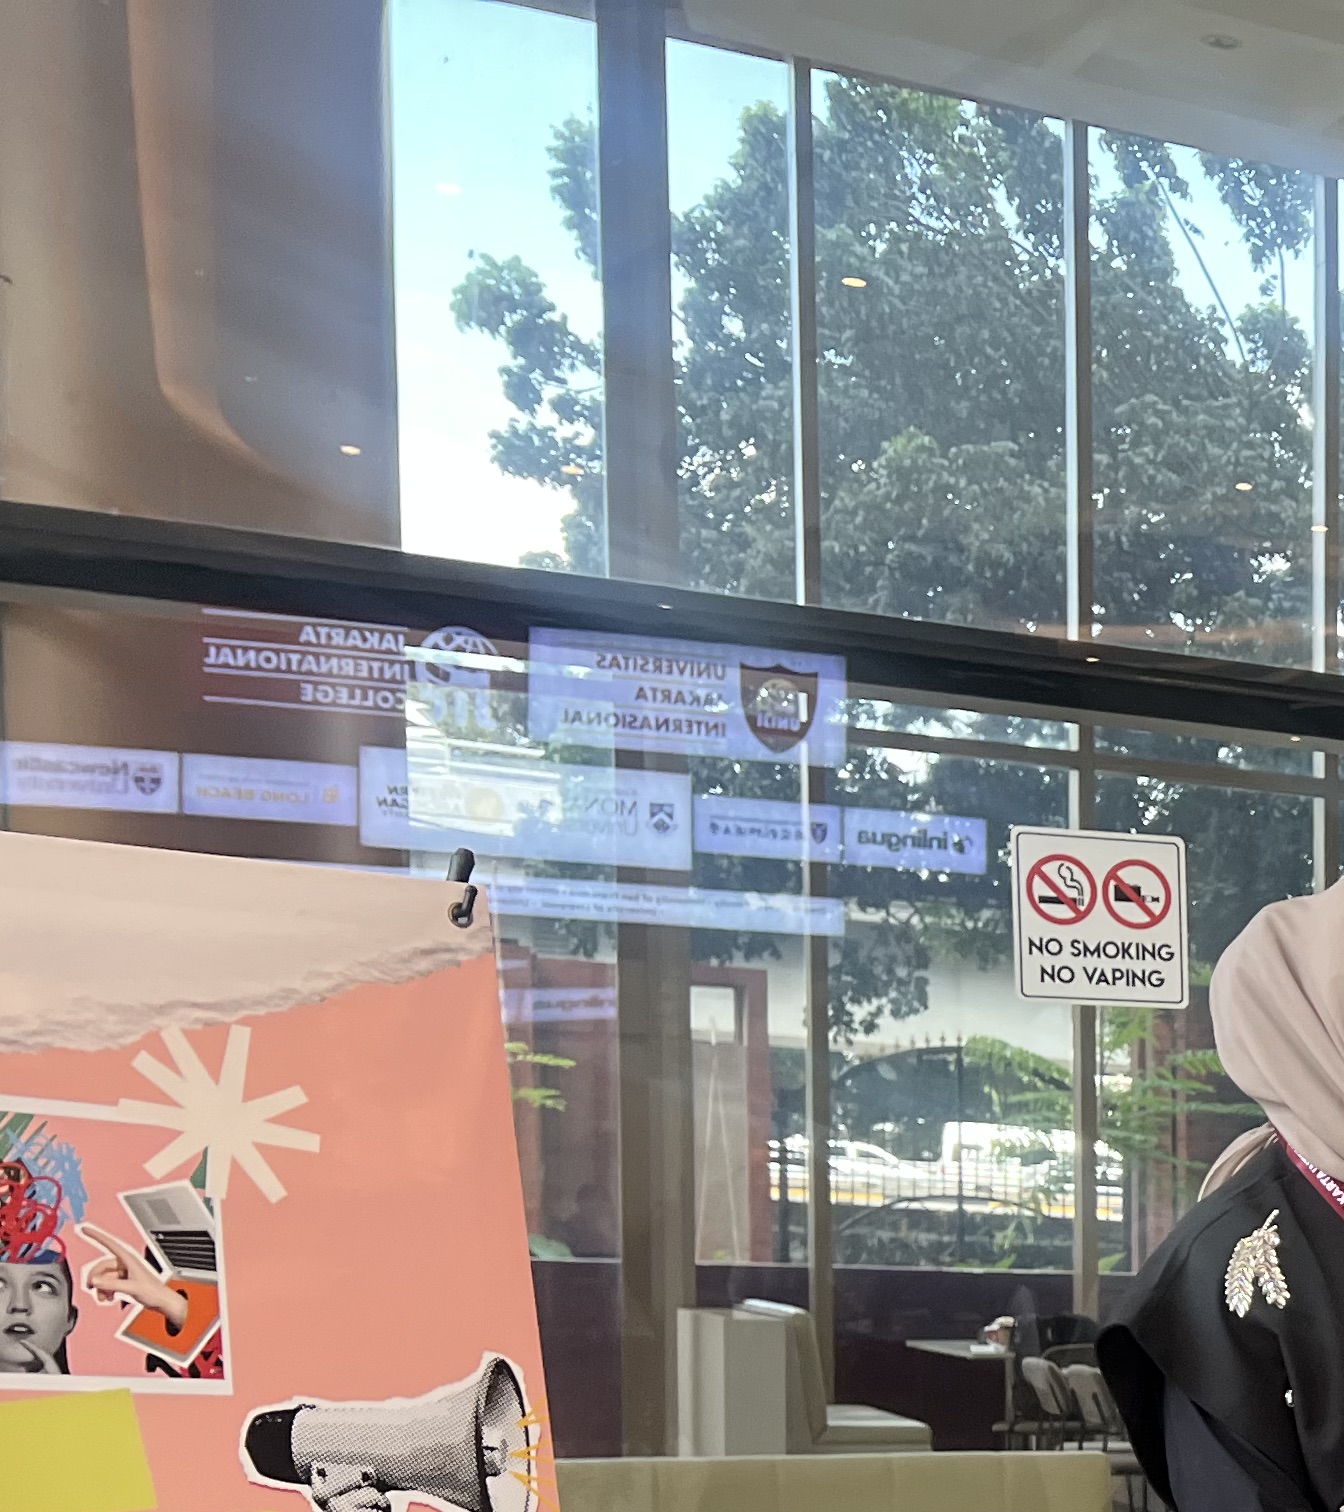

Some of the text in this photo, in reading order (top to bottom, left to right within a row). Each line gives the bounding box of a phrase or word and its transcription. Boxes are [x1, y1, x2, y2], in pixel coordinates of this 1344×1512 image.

[1028, 937, 1175, 962] NO SMOKING
[1040, 964, 1165, 988] NO VAPING
